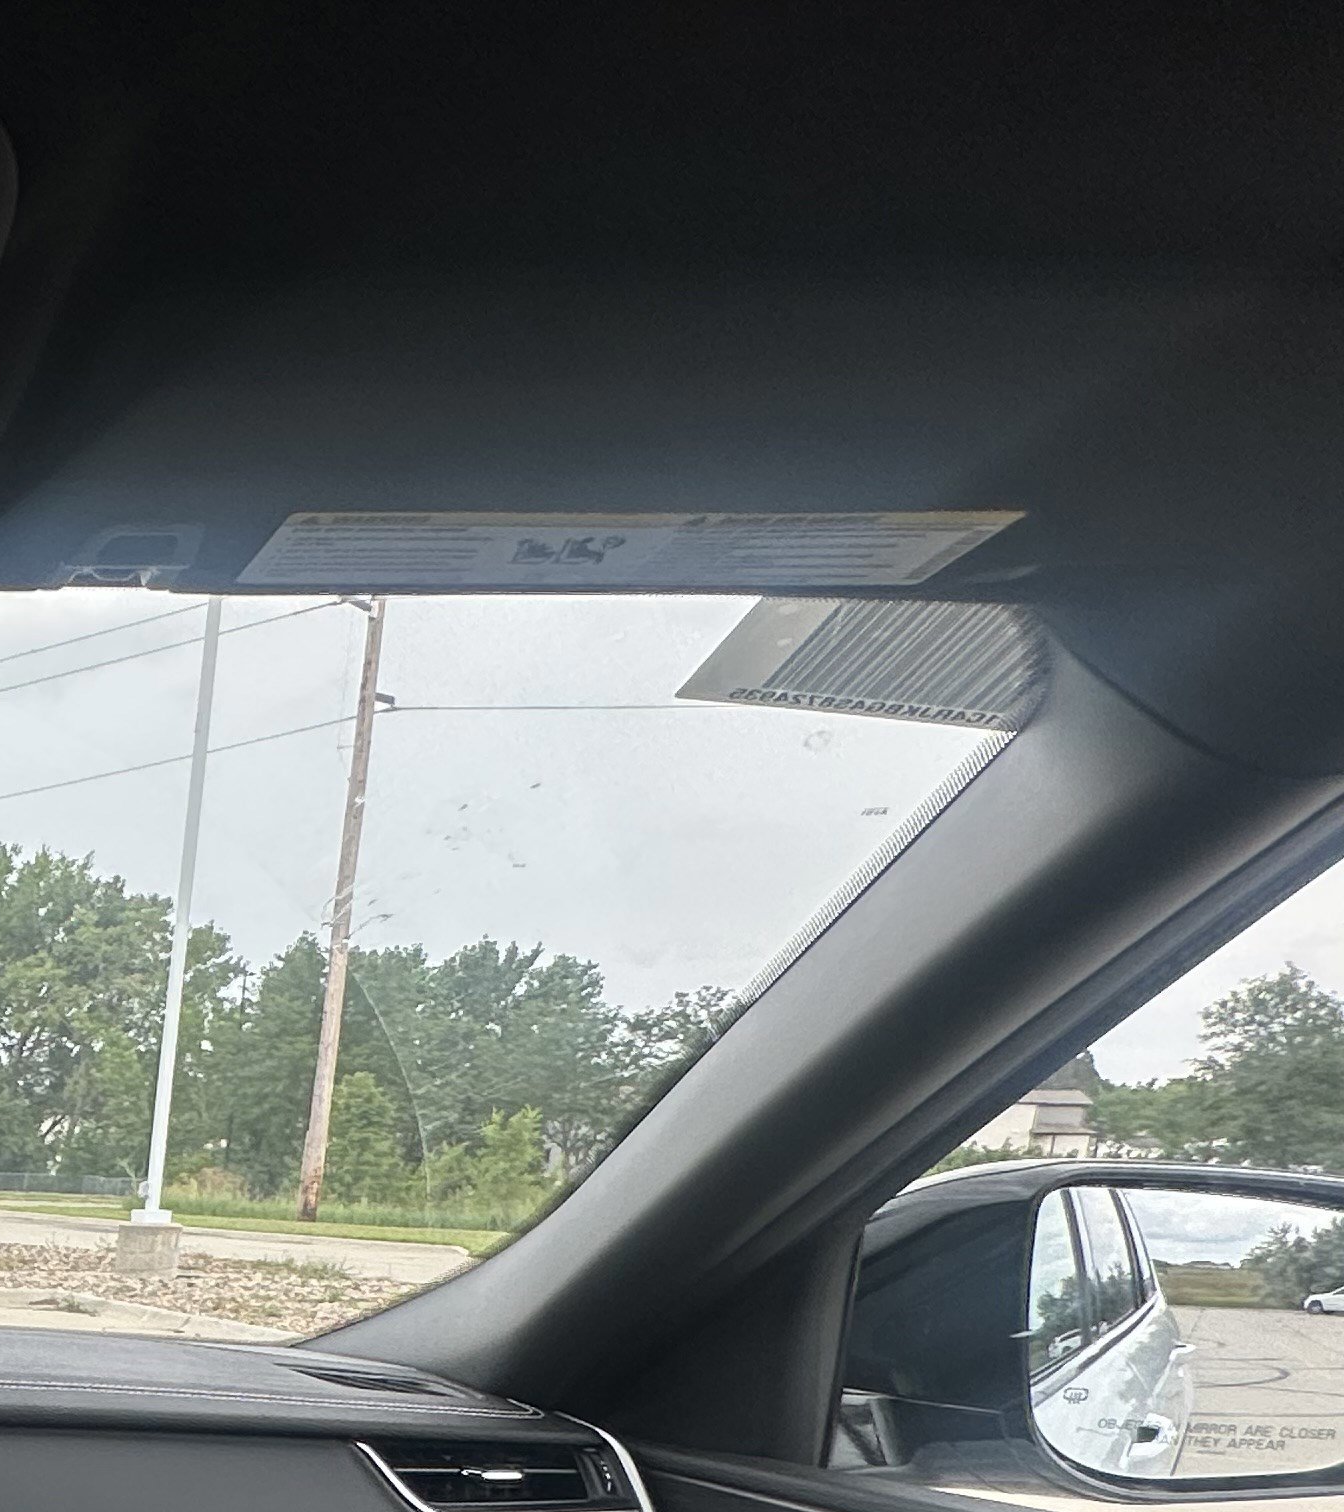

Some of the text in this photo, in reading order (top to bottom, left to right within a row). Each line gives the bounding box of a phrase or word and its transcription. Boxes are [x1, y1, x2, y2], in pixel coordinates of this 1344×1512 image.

[1243, 1424, 1275, 1437] ARE
[1278, 1427, 1337, 1440] CLOSER
[1186, 1435, 1220, 1448] THEY
[1226, 1438, 1286, 1450] APPEAR
